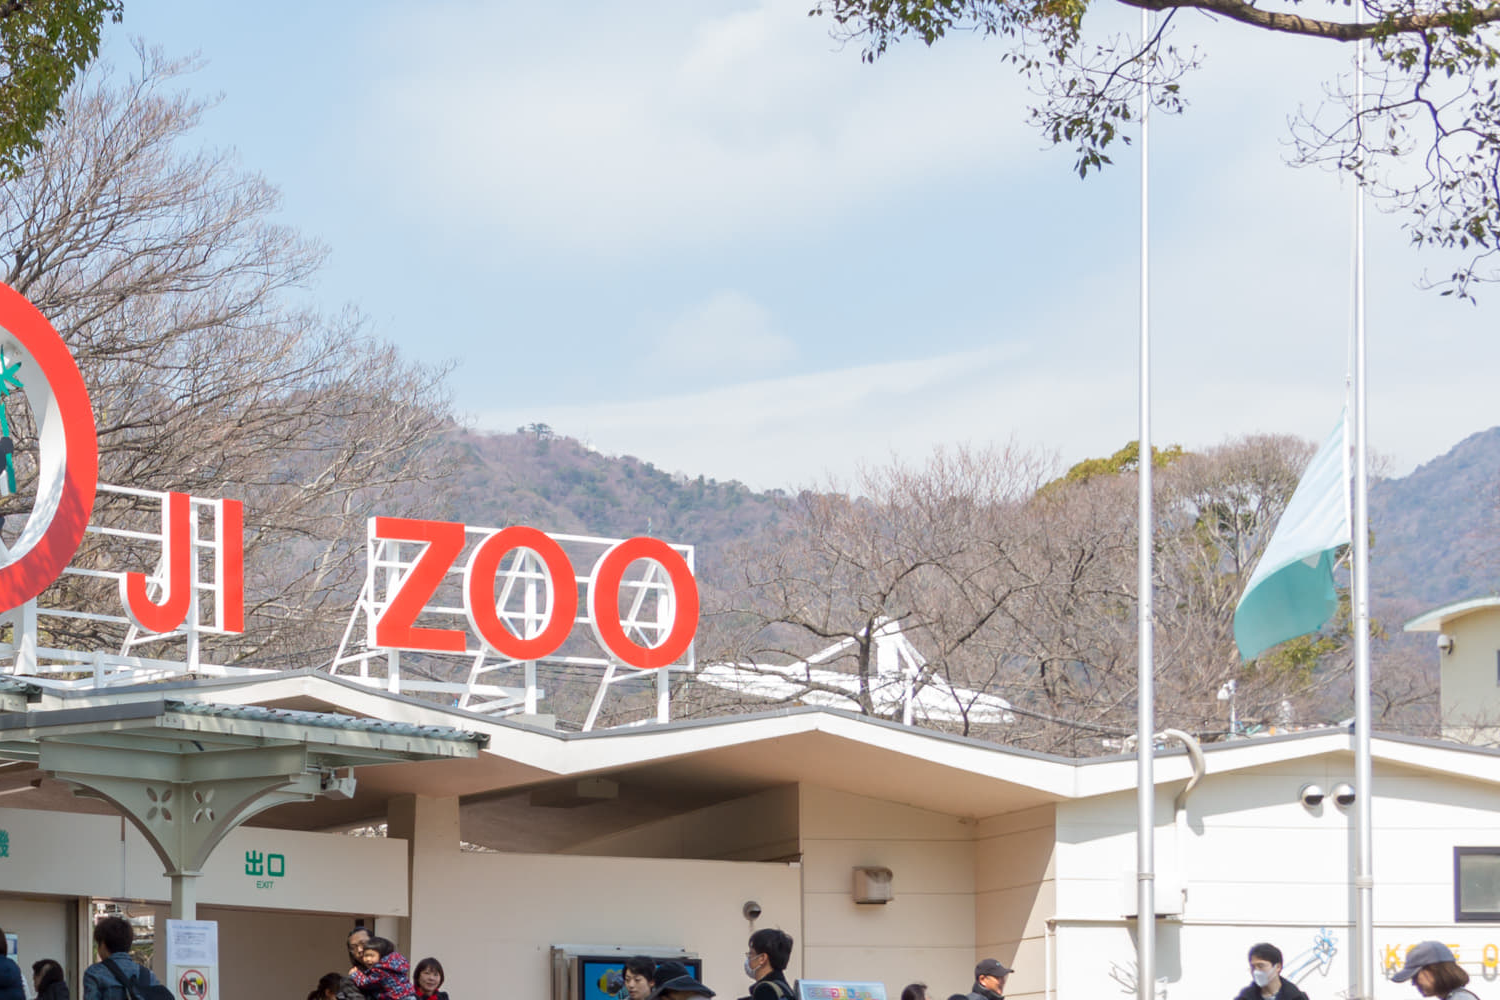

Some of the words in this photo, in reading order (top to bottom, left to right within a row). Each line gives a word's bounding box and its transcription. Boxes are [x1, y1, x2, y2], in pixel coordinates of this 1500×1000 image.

[375, 516, 699, 669] ZOO
[245, 850, 285, 877] 出口
[256, 880, 274, 889] EXIT
